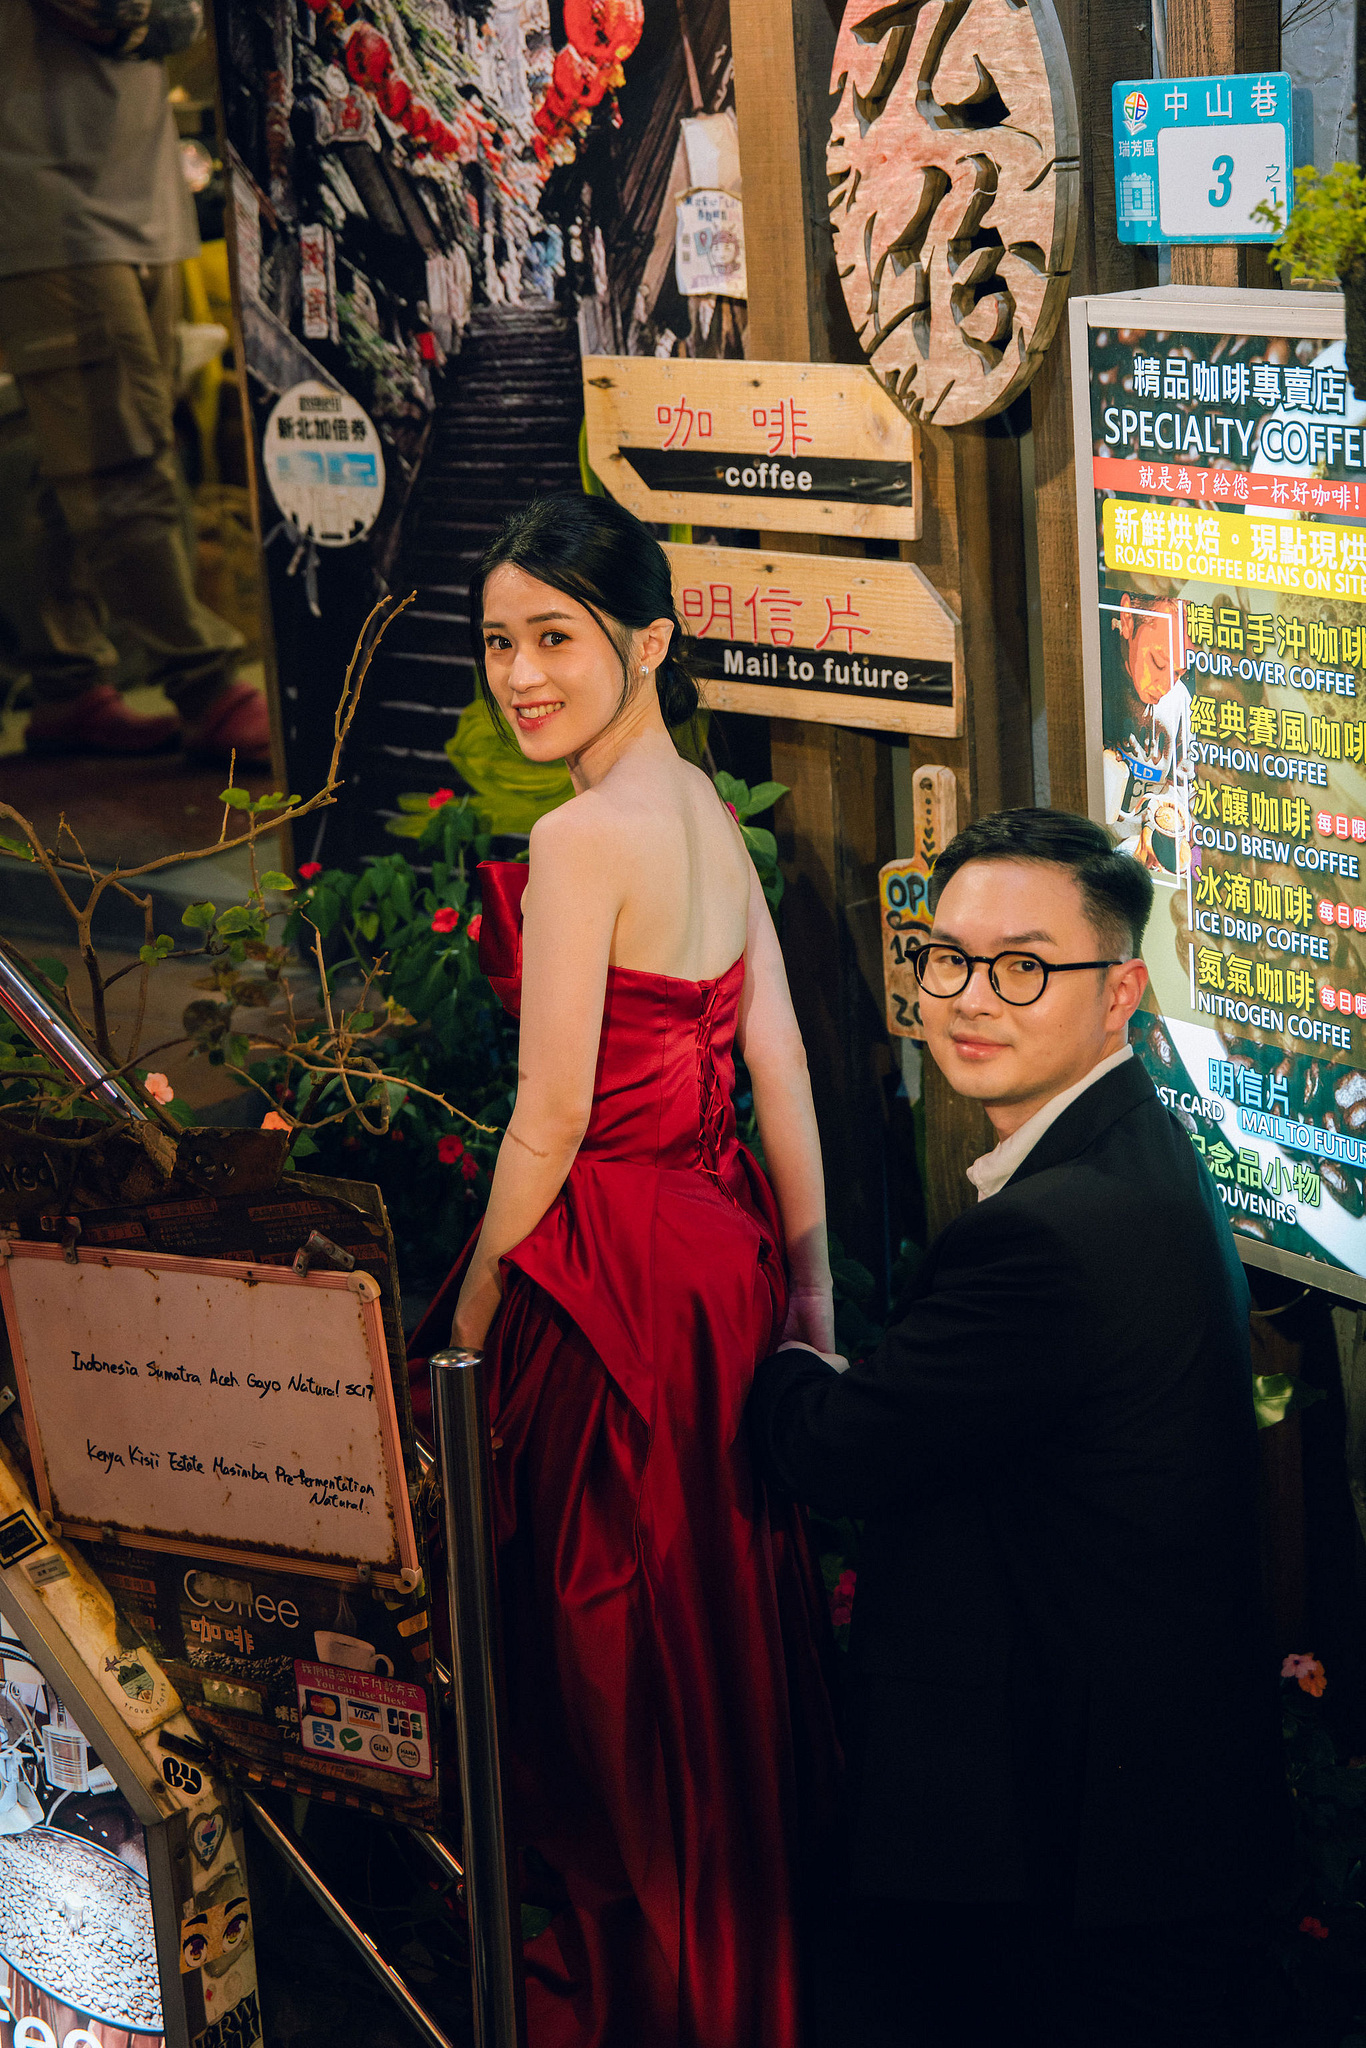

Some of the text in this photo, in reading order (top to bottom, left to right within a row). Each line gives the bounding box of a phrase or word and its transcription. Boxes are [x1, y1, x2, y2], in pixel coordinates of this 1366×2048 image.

[1164, 81, 1277, 121] 中山巷
[1118, 139, 1155, 157] 瑞芳區
[1208, 155, 1234, 208] 3
[1133, 357, 1344, 413] 精品咖啡專賣店
[277, 416, 366, 441] 新北加倍券
[657, 396, 813, 457] 咖啡
[1104, 408, 1366, 468] SPECIALTY COFFE
[724, 462, 813, 491] coffee
[1116, 545, 1183, 571] ROASTED
[1186, 554, 1242, 579] COFFEE
[1247, 562, 1300, 587] BEANS
[1304, 569, 1330, 591] ON
[682, 584, 871, 653] 明信片
[724, 649, 909, 690] Mail to future
[1186, 650, 1356, 696] POUR-OVER COFFEE
[1190, 741, 1327, 785] SYPHON COFFEE
[1193, 780, 1311, 839] 冰釀咖啡
[1193, 825, 1359, 878] COLD BREW COFFEE
[1195, 866, 1313, 928] 冰滴咖啡
[1195, 909, 1329, 960] ICE DRIP COFFEE
[1197, 946, 1315, 1011] 氮氣咖啡
[1198, 991, 1352, 1049] NITROGEN COFFEE
[1180, 1093, 1224, 1122] CARD
[1208, 1057, 1290, 1116] 明信片
[1242, 1109, 1284, 1140] MAIL
[1286, 1122, 1310, 1147] TO
[1217, 1183, 1297, 1225] OUVENIRS
[71, 1350, 140, 1377] Indonesia
[146, 1360, 202, 1385] Sumatra
[210, 1368, 240, 1387] Aceh
[247, 1373, 281, 1399] Gayo
[288, 1373, 340, 1397] Natural
[87, 1438, 125, 1474] Kenya
[129, 1444, 160, 1469] Kisii
[168, 1451, 205, 1474] Estate
[190, 1615, 254, 1655] 咖啡
[315, 1678, 407, 1707] You can use these
[354, 1708, 422, 1736] VISA JCB
[373, 1743, 389, 1754] GLN
[400, 1748, 417, 1757] HANA
